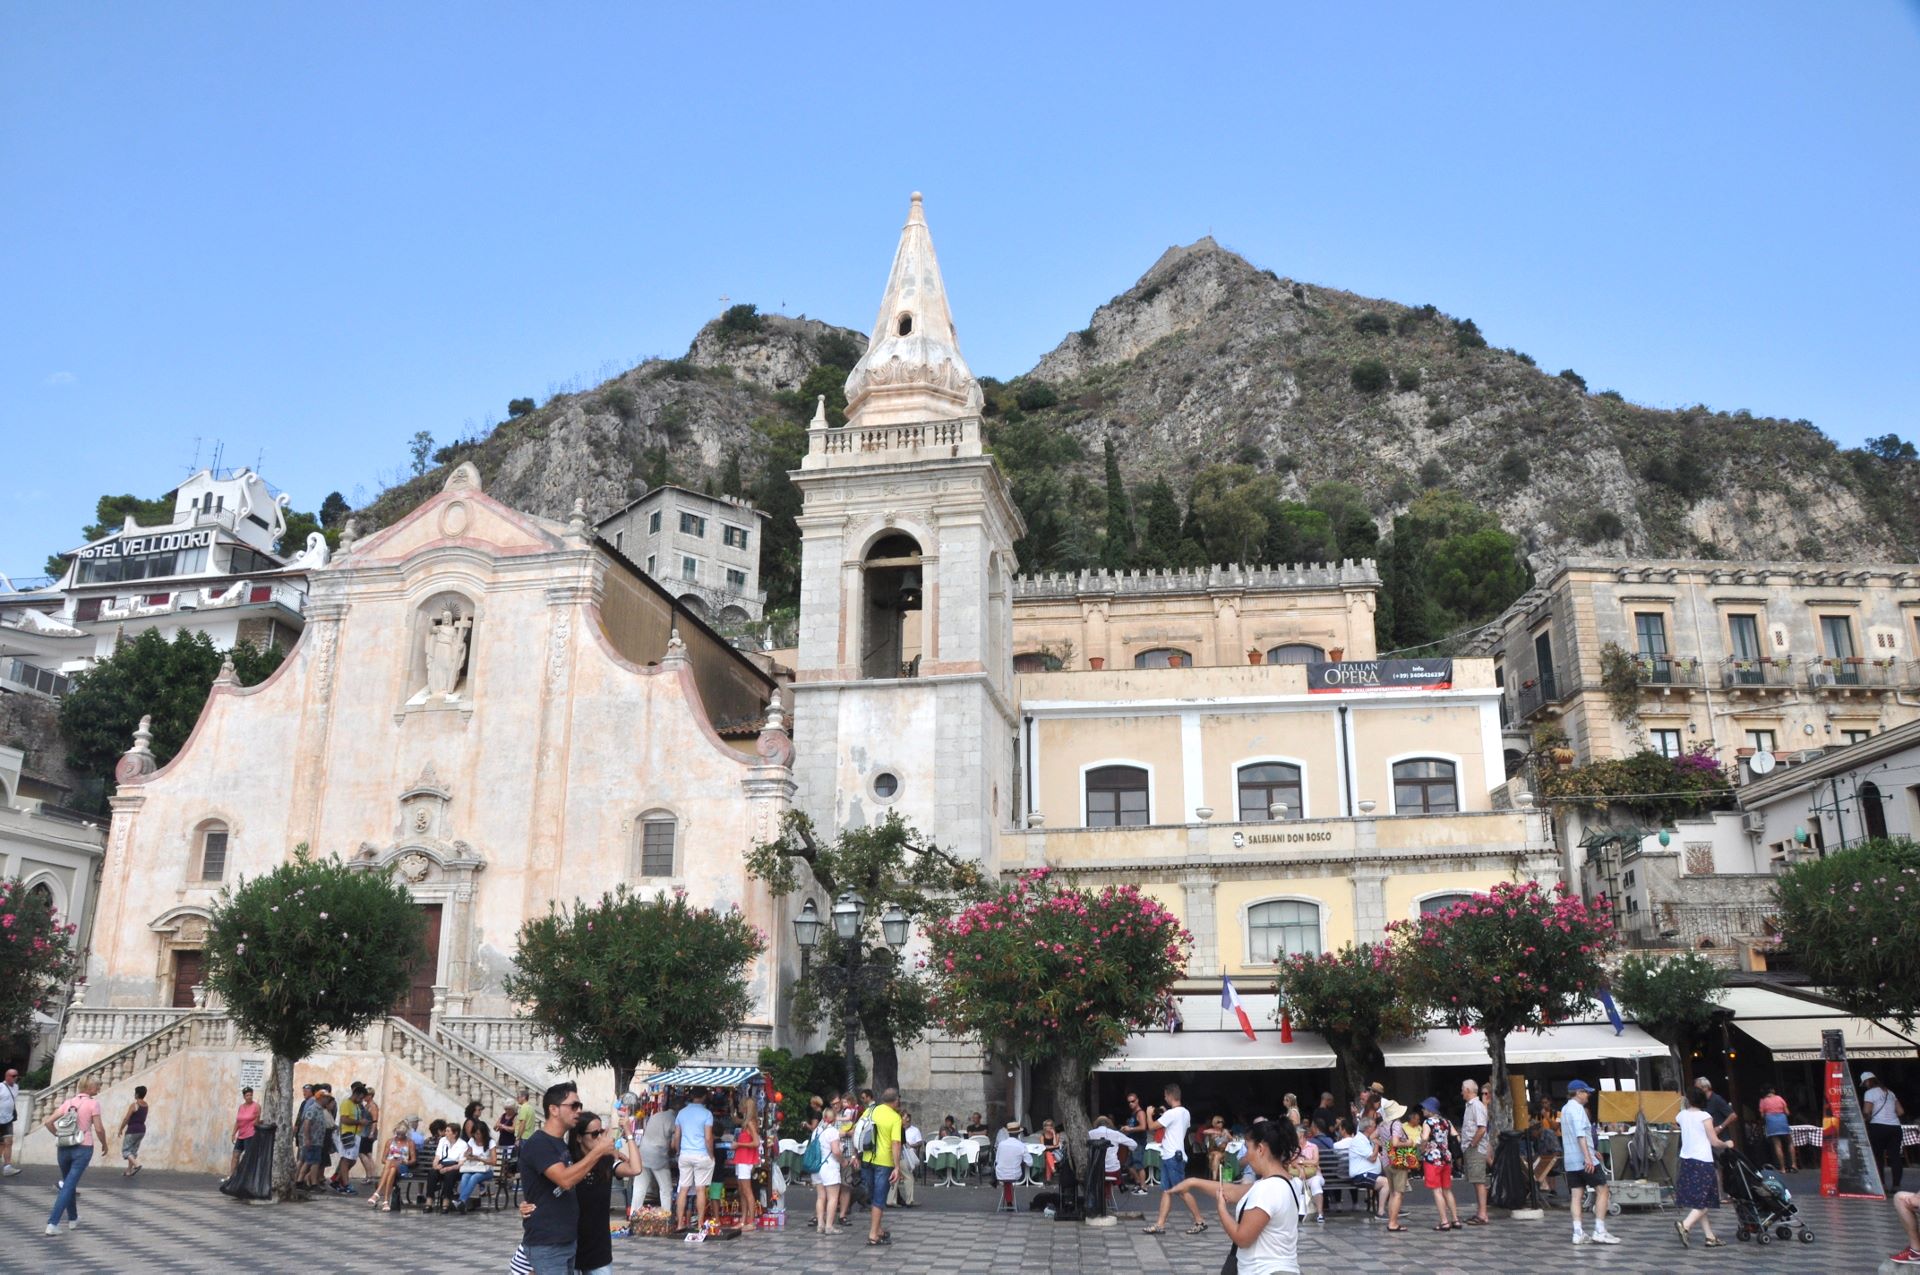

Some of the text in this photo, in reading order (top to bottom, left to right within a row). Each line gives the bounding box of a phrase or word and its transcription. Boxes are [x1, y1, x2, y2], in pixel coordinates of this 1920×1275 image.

[79, 543, 120, 559] HOTEL
[1338, 663, 1378, 671] ITALIAN
[1324, 669, 1380, 685] OPERA
[1248, 832, 1332, 844] SALESIANI DON BOSCO
[1858, 1050, 1876, 1058] NO
[1878, 1049, 1909, 1057] STOP
